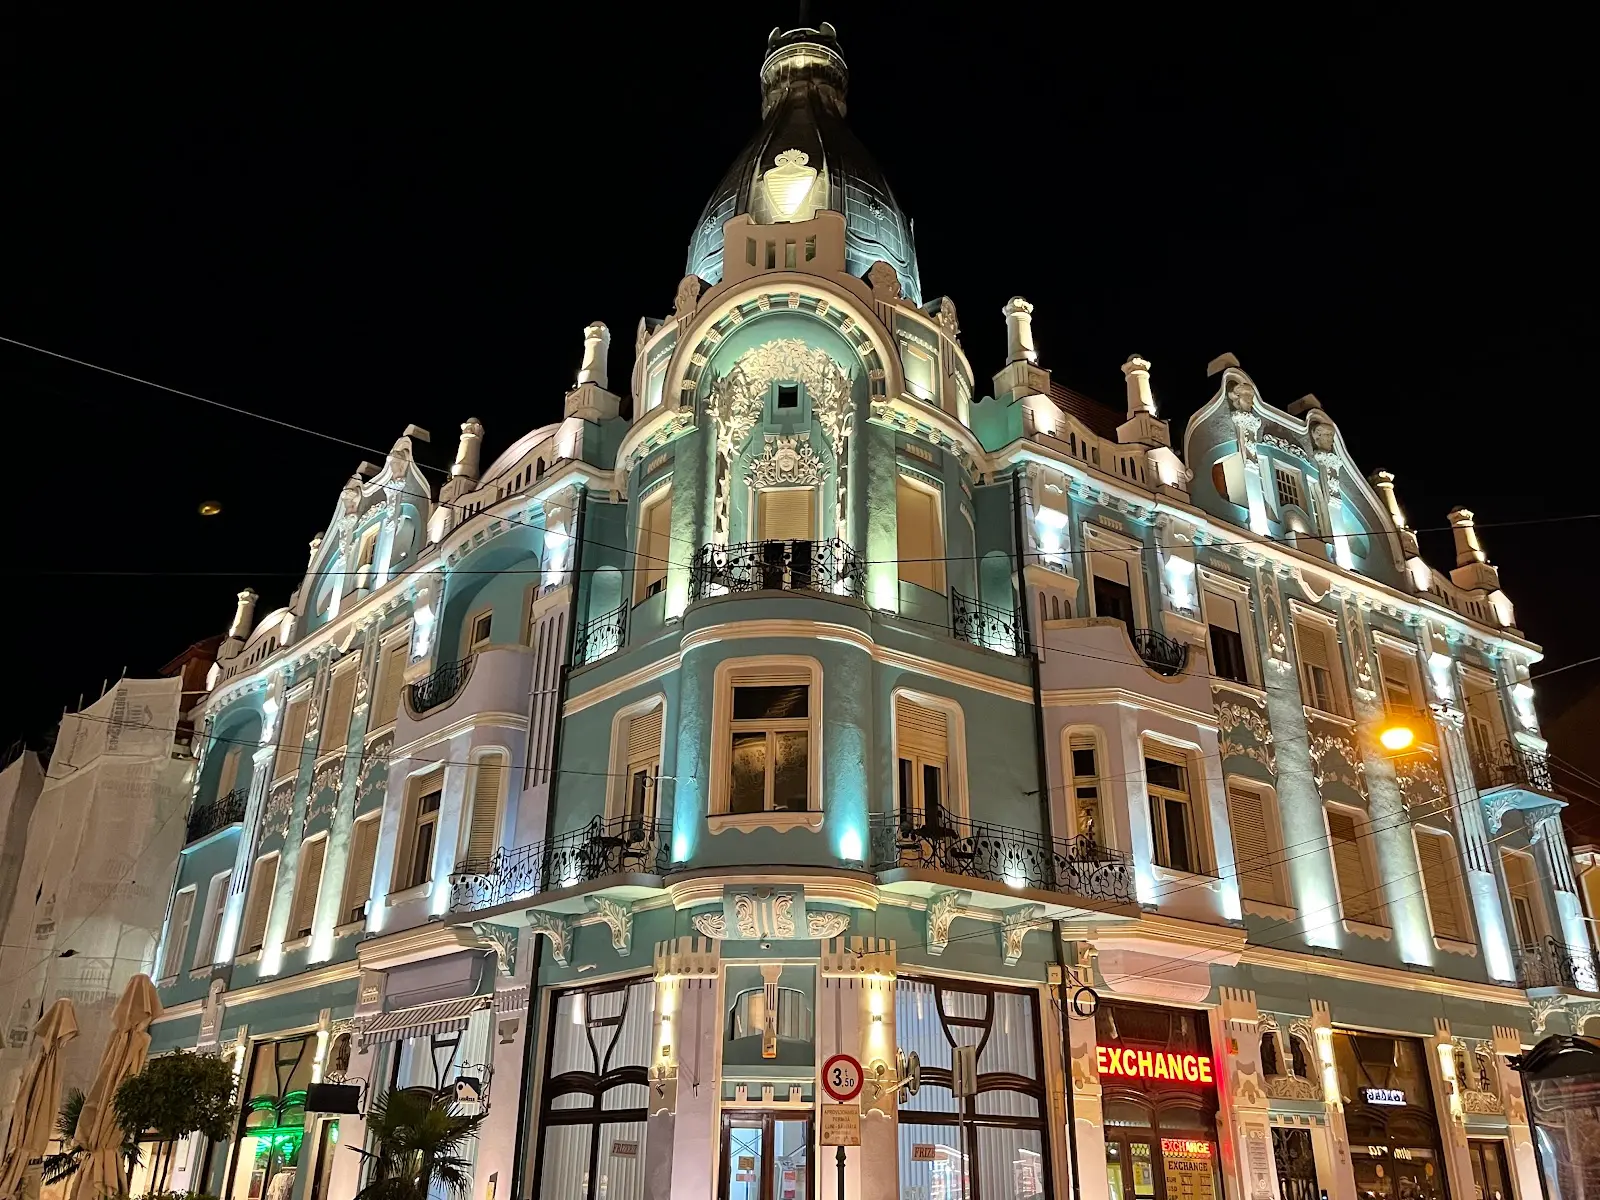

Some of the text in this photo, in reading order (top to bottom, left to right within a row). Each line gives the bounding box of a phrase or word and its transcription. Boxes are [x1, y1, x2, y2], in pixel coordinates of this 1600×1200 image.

[1096, 1046, 1213, 1083] EXCHANGE
[1161, 1140, 1211, 1154] EXCHANGE
[1168, 1161, 1208, 1172] EXCHANGE
